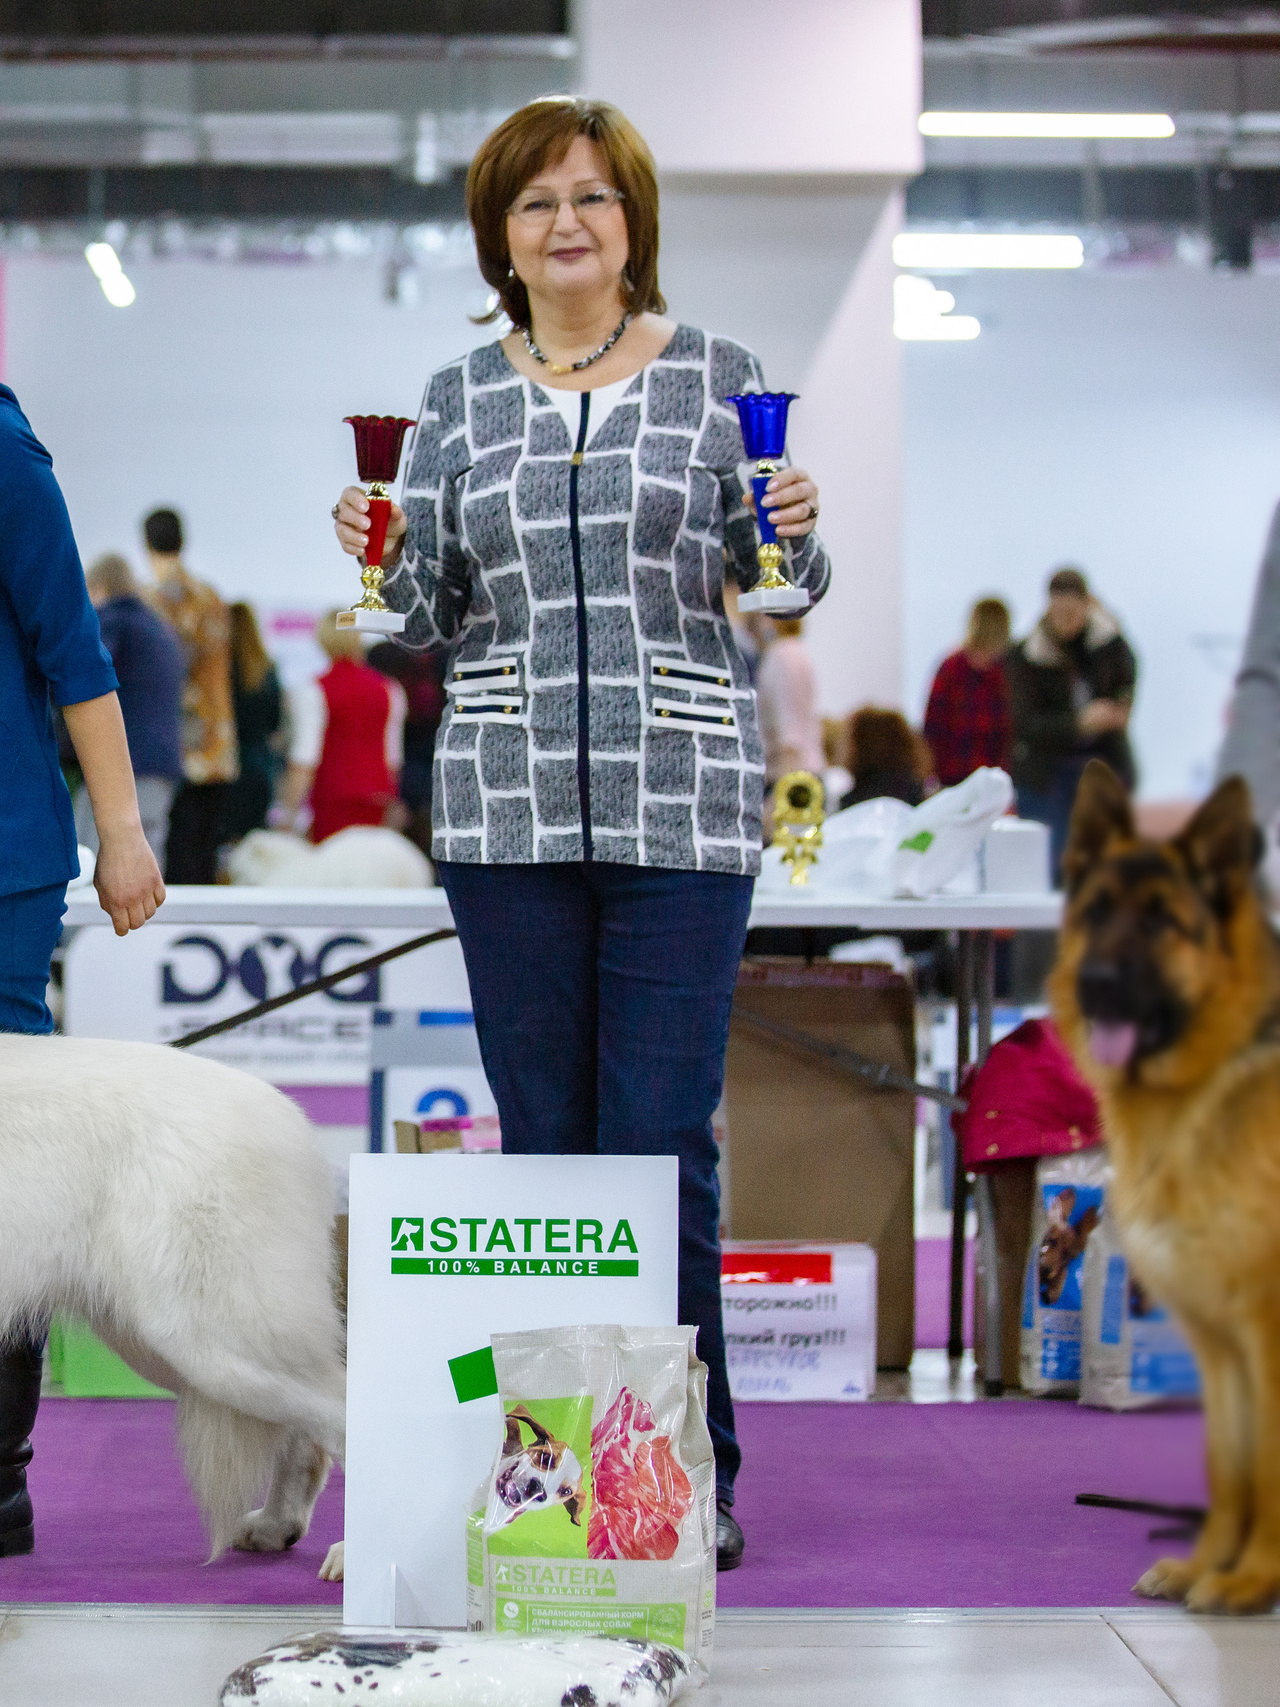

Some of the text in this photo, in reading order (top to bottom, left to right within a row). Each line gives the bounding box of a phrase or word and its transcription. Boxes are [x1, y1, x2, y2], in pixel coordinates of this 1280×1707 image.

[429, 1216, 639, 1254] STATERA
[427, 1259, 600, 1275] 100% BALANCE
[513, 1565, 617, 1586] STATERA
[512, 1585, 597, 1596] 100% BALANCE
[531, 1608, 644, 1619] СБАЛАНСИРОВАННЫЙ КОРМ
[531, 1618, 550, 1626] ДЛЯ
[552, 1619, 601, 1627] ВЗРОСЛЫХ
[603, 1620, 632, 1628] СОБАК
